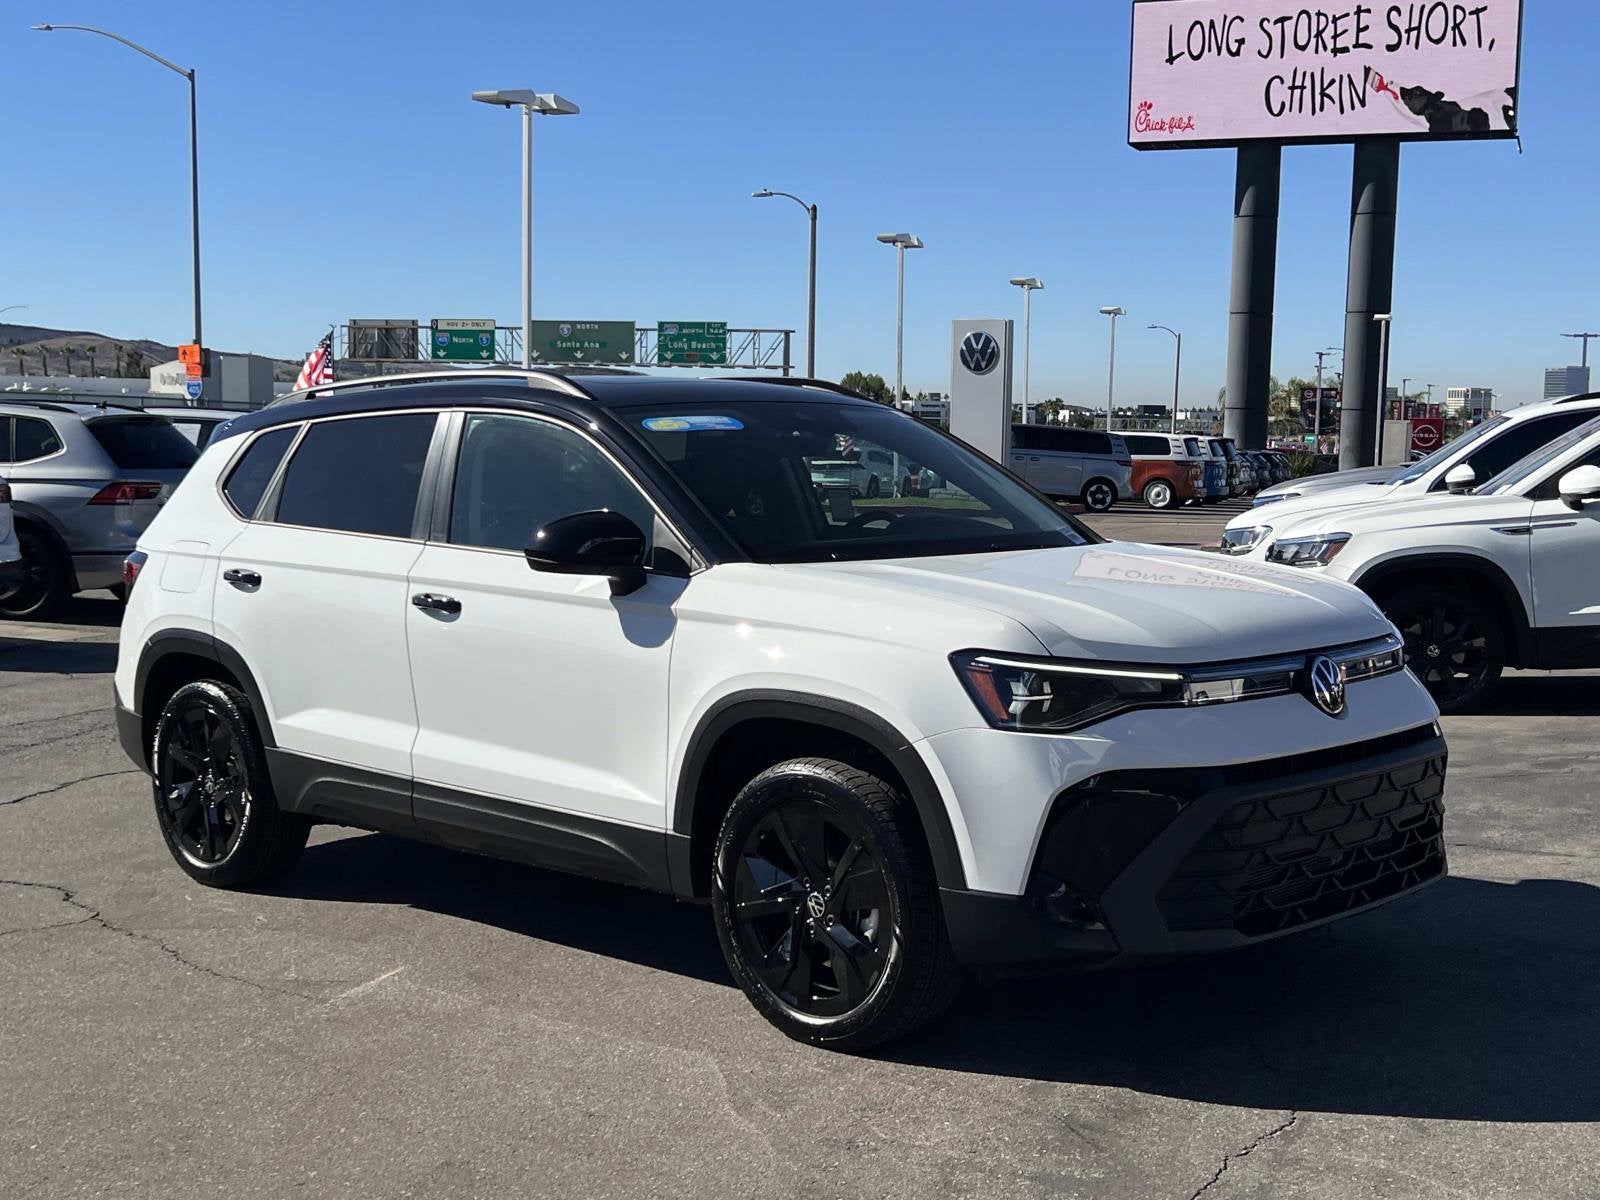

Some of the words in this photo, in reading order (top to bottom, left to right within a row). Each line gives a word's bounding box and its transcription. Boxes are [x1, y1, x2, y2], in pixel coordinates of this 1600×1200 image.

[1165, 15, 1245, 65] LONG
[1257, 4, 1374, 60] STOREE
[1386, 1, 1495, 52] SHORT,
[1264, 65, 1369, 118] CHIKIN
[1135, 108, 1195, 134] Chick-fil-A
[556, 340, 580, 348] Santa
[583, 340, 600, 348] Ana
[668, 341, 688, 350] Long
